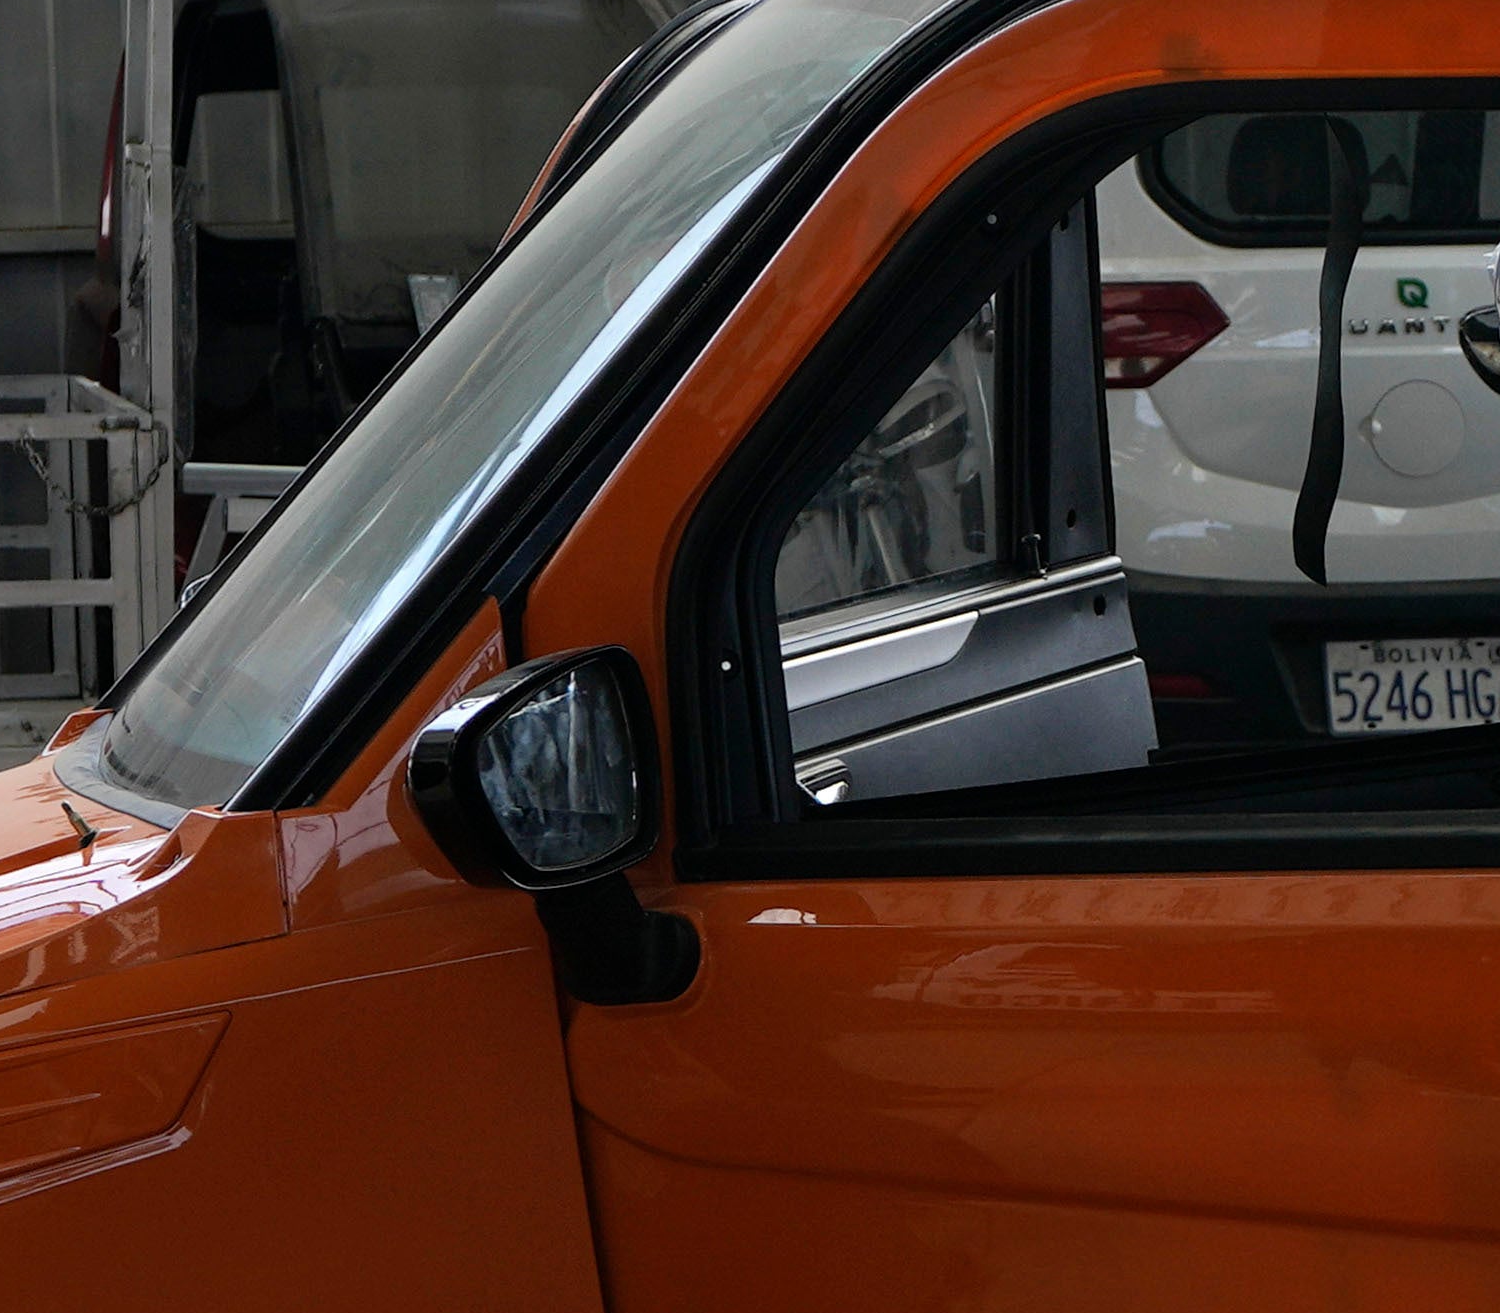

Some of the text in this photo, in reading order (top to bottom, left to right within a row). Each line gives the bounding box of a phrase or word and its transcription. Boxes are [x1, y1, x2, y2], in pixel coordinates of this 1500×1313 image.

[1348, 315, 1451, 334] UANT
[1372, 645, 1473, 663] BOLIVIA
[1333, 670, 1433, 723] 5246
